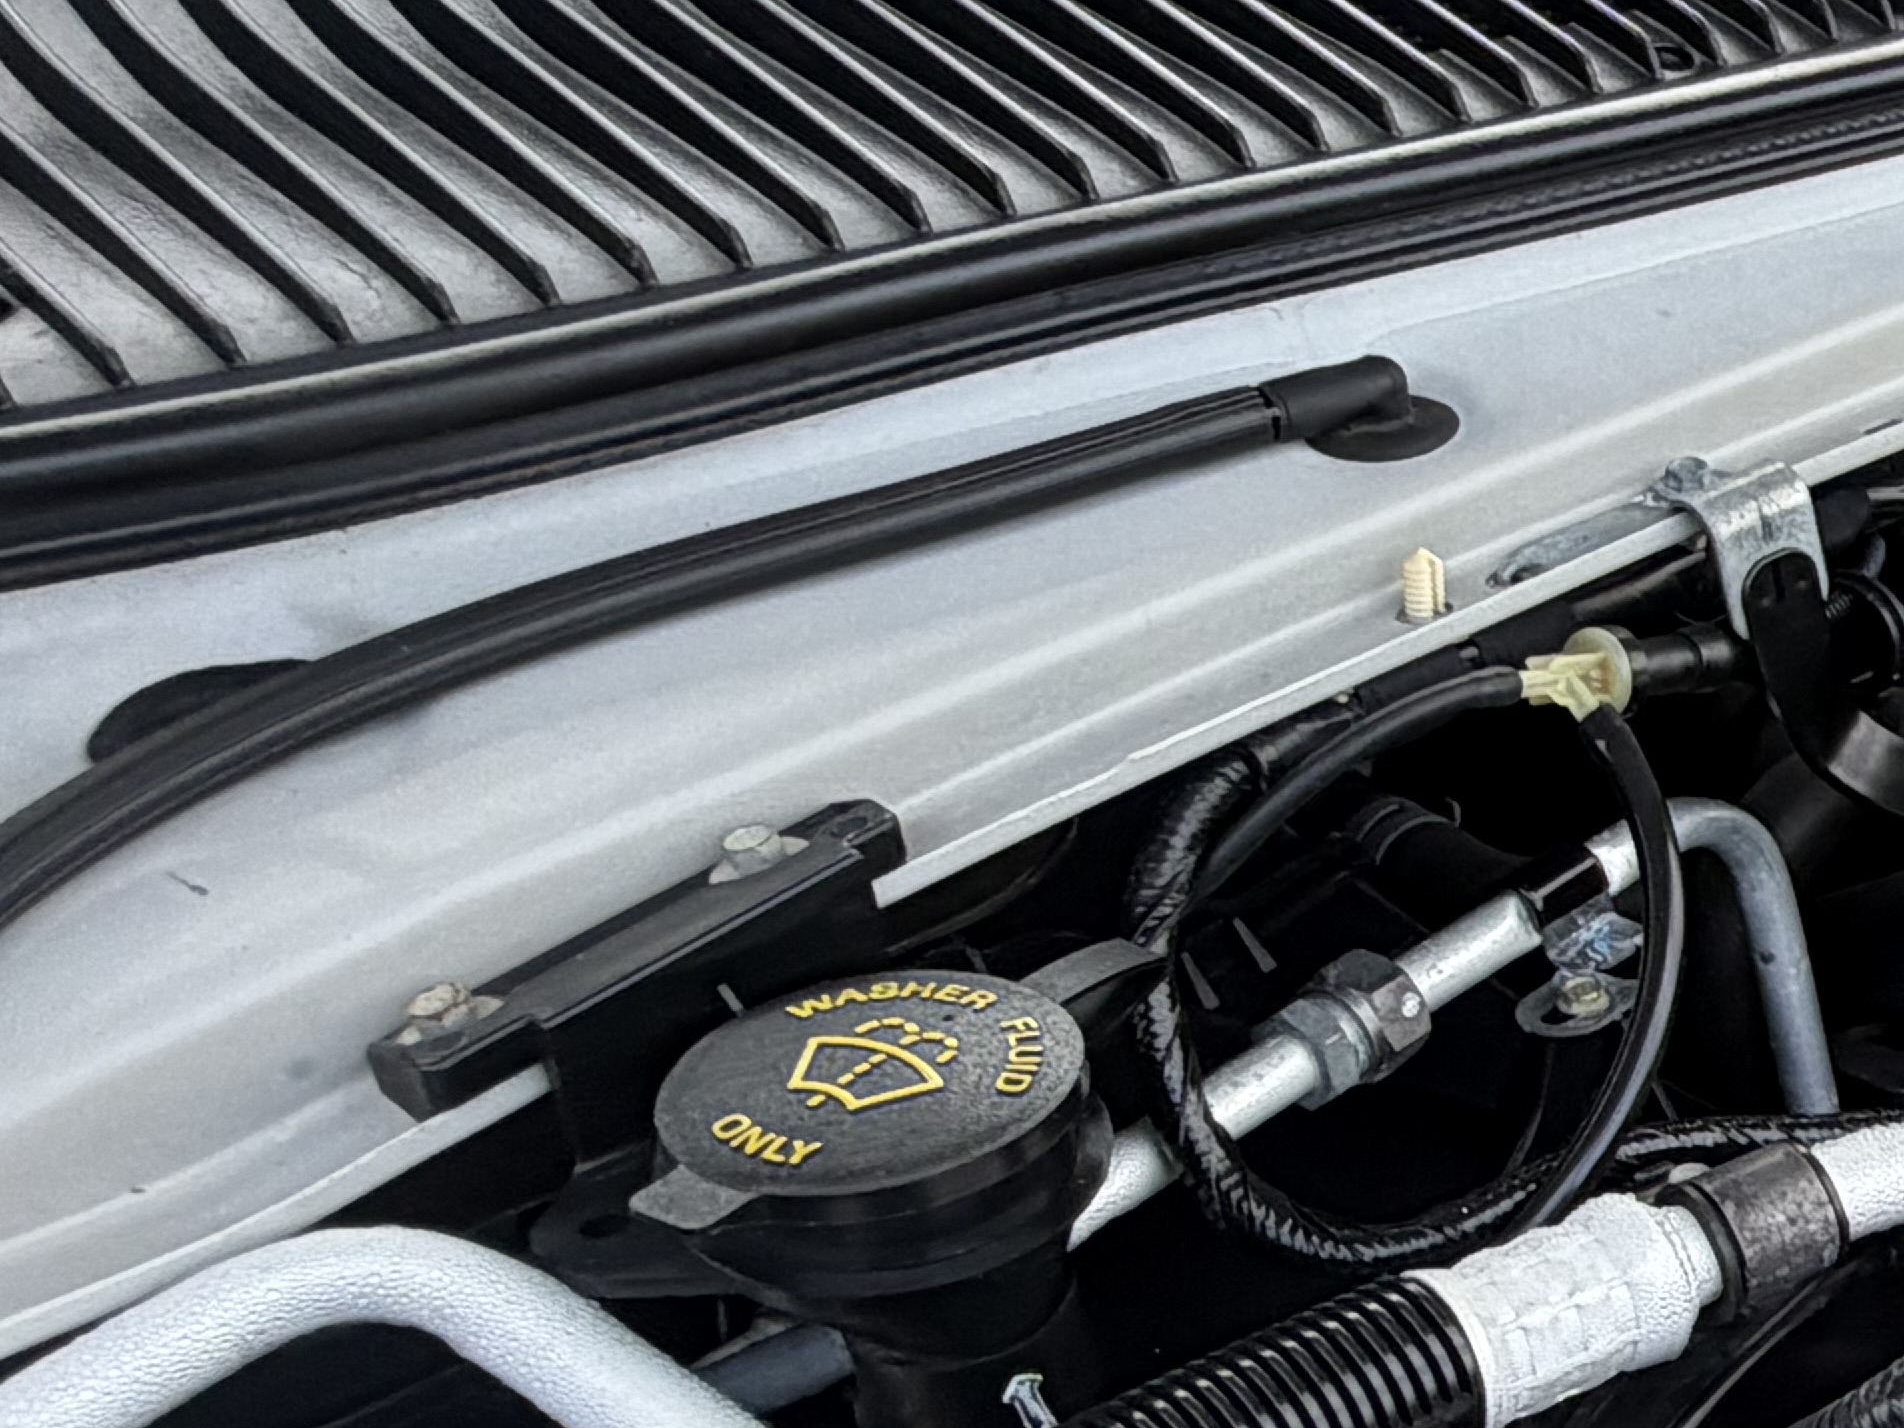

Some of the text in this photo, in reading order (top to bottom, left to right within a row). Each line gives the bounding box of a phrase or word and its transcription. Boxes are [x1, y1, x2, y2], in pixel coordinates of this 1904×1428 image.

[785, 980, 997, 1020] WASHER
[996, 1016, 1043, 1096] FLUID
[711, 1113, 825, 1166] ONLY
